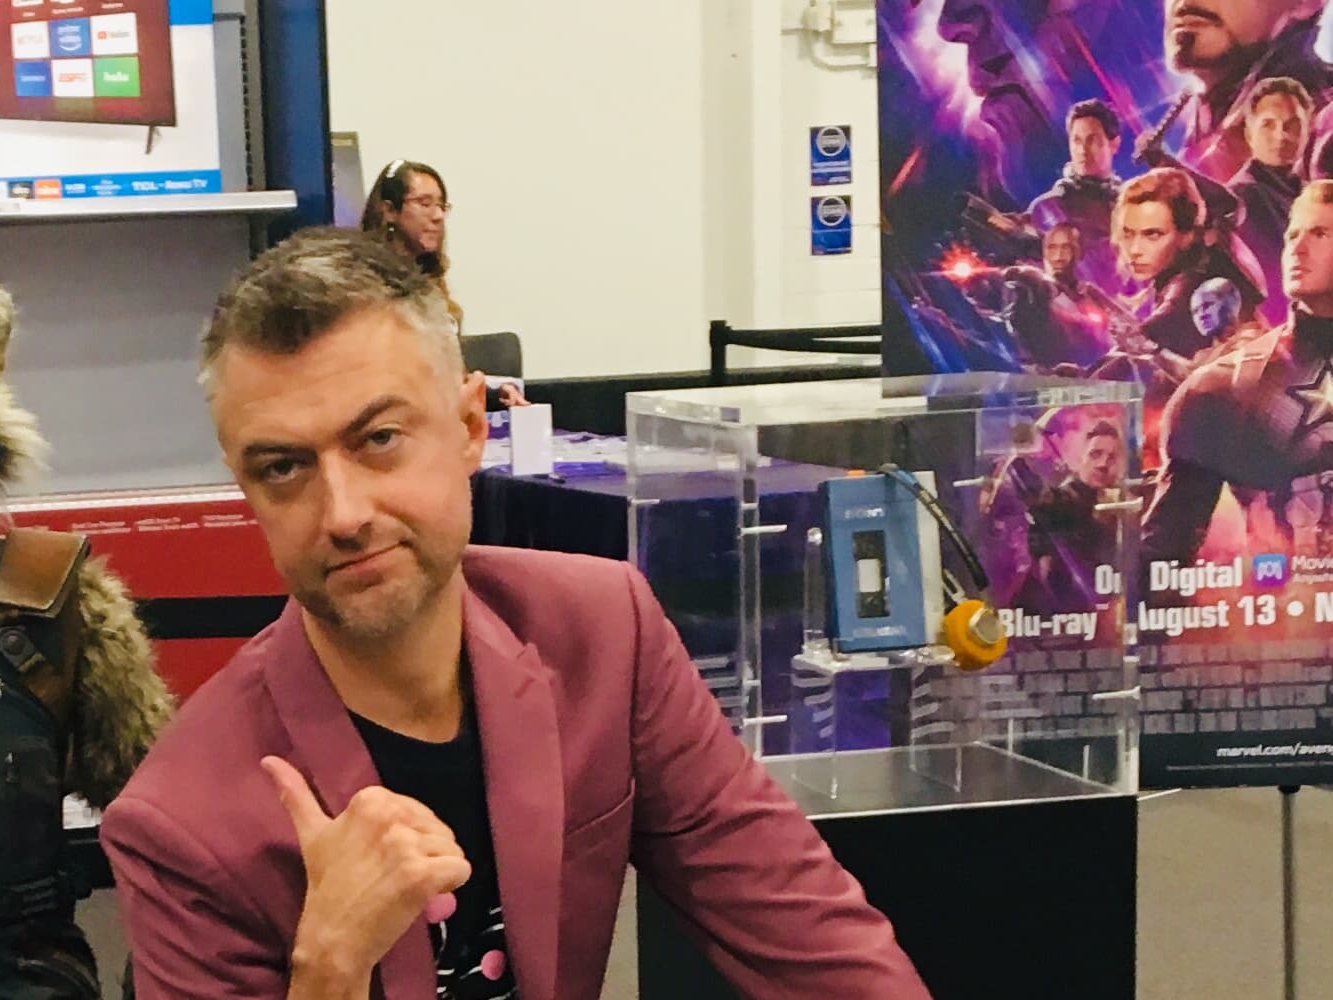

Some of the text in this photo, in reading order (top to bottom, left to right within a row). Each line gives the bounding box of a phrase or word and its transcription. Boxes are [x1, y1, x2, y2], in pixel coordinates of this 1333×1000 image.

[1150, 558, 1243, 597] Digital
[997, 608, 1098, 641] Blu-ray
[1238, 594, 1276, 626] 13
